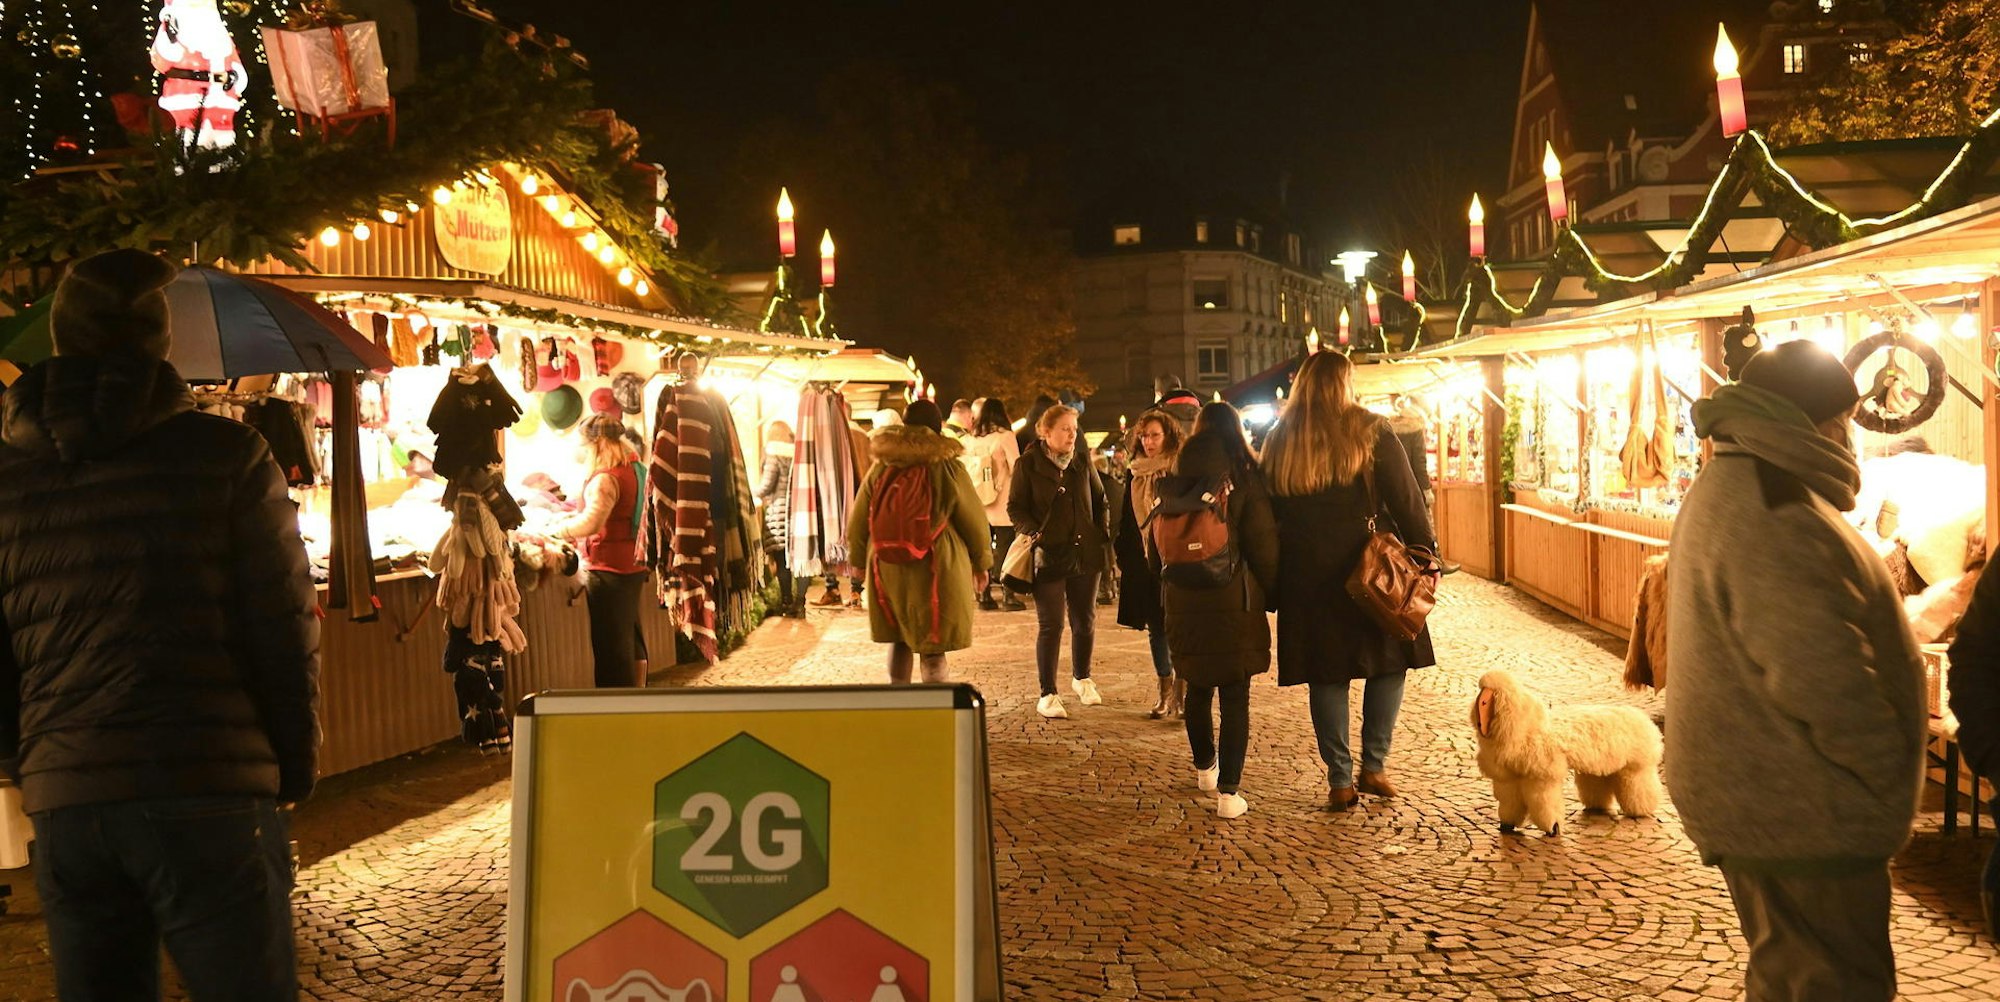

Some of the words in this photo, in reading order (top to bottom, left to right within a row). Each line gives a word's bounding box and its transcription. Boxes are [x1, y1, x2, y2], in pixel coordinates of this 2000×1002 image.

[456, 209, 508, 242] Mützen
[679, 791, 802, 872] 2G
[731, 874, 753, 884] ODER
